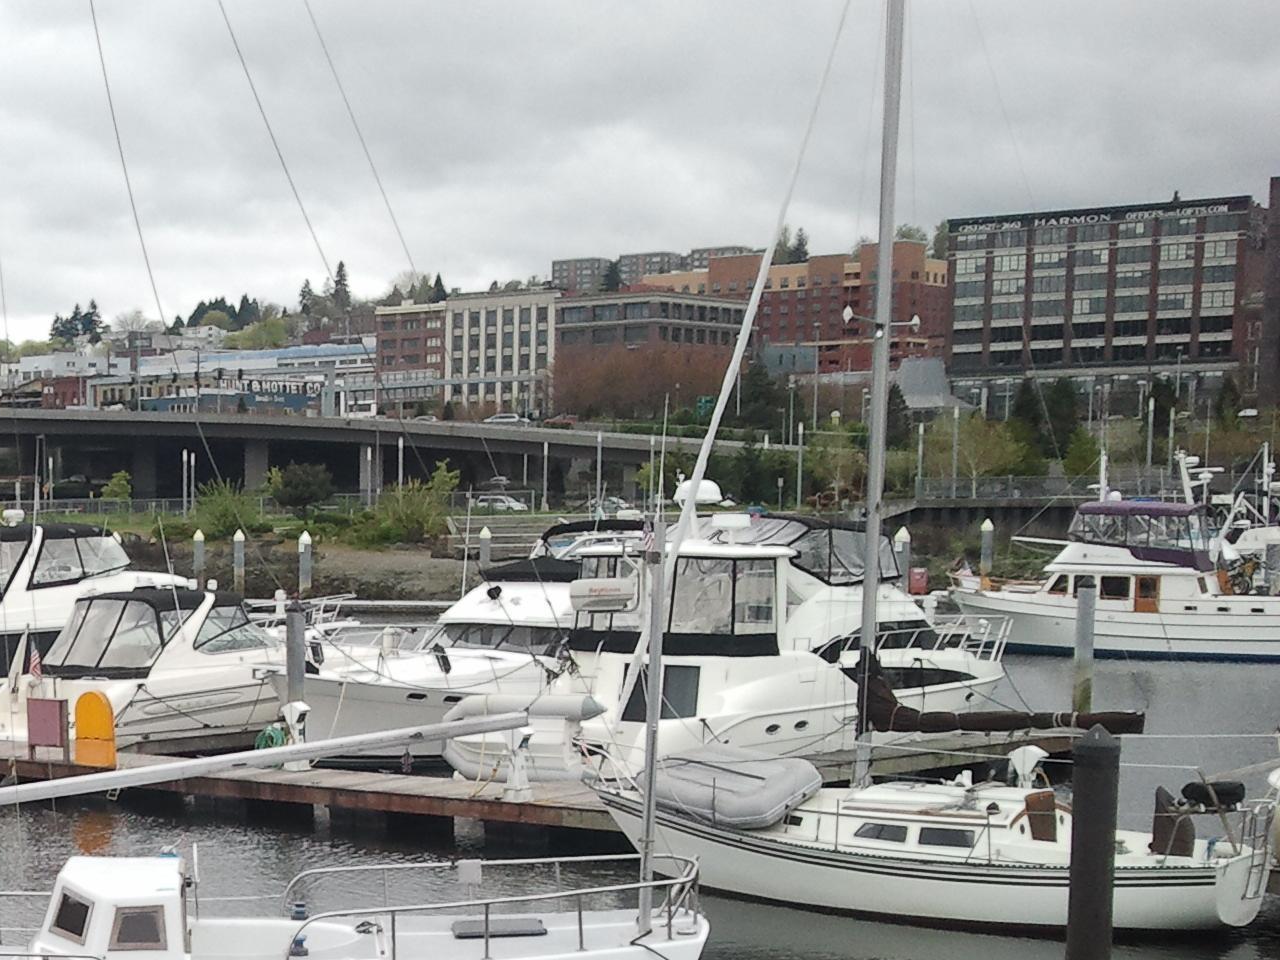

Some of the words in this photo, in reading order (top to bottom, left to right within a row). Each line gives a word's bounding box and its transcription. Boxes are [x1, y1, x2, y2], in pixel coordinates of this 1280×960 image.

[1033, 213, 1112, 227] HARMON
[219, 379, 250, 392] HUNT
[251, 380, 261, 392] &
[262, 381, 304, 394] MOTTET
